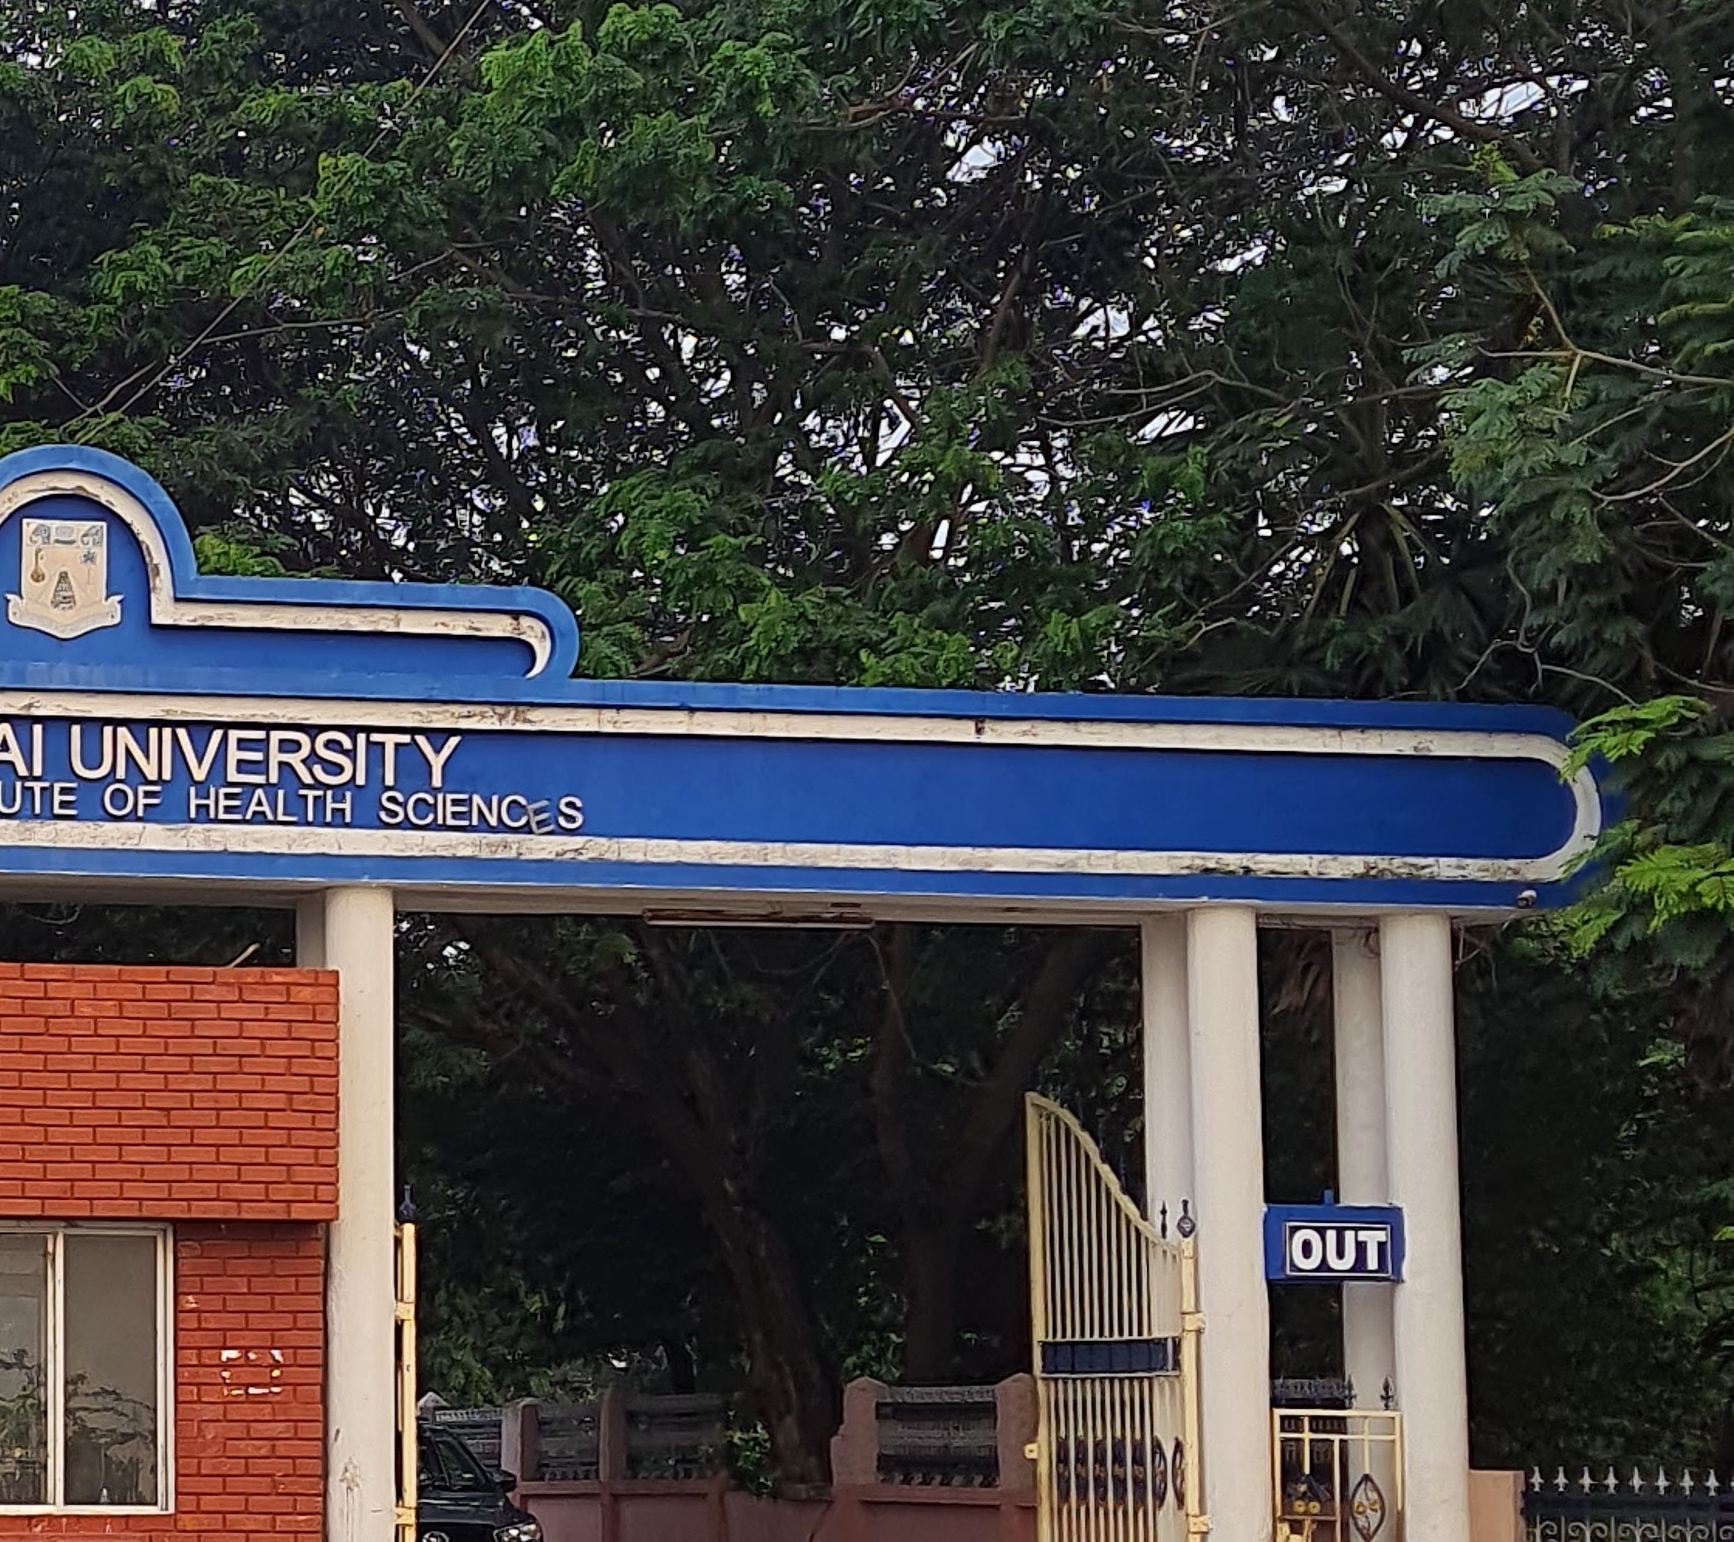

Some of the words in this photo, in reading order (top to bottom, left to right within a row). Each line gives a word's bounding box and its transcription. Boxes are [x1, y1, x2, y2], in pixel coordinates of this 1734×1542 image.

[69, 723, 463, 789] UNIVERSITY
[103, 782, 163, 818] OF
[188, 784, 352, 824] HEALTH
[377, 791, 584, 836] SCIENCES
[1291, 1228, 1388, 1271] OUT
